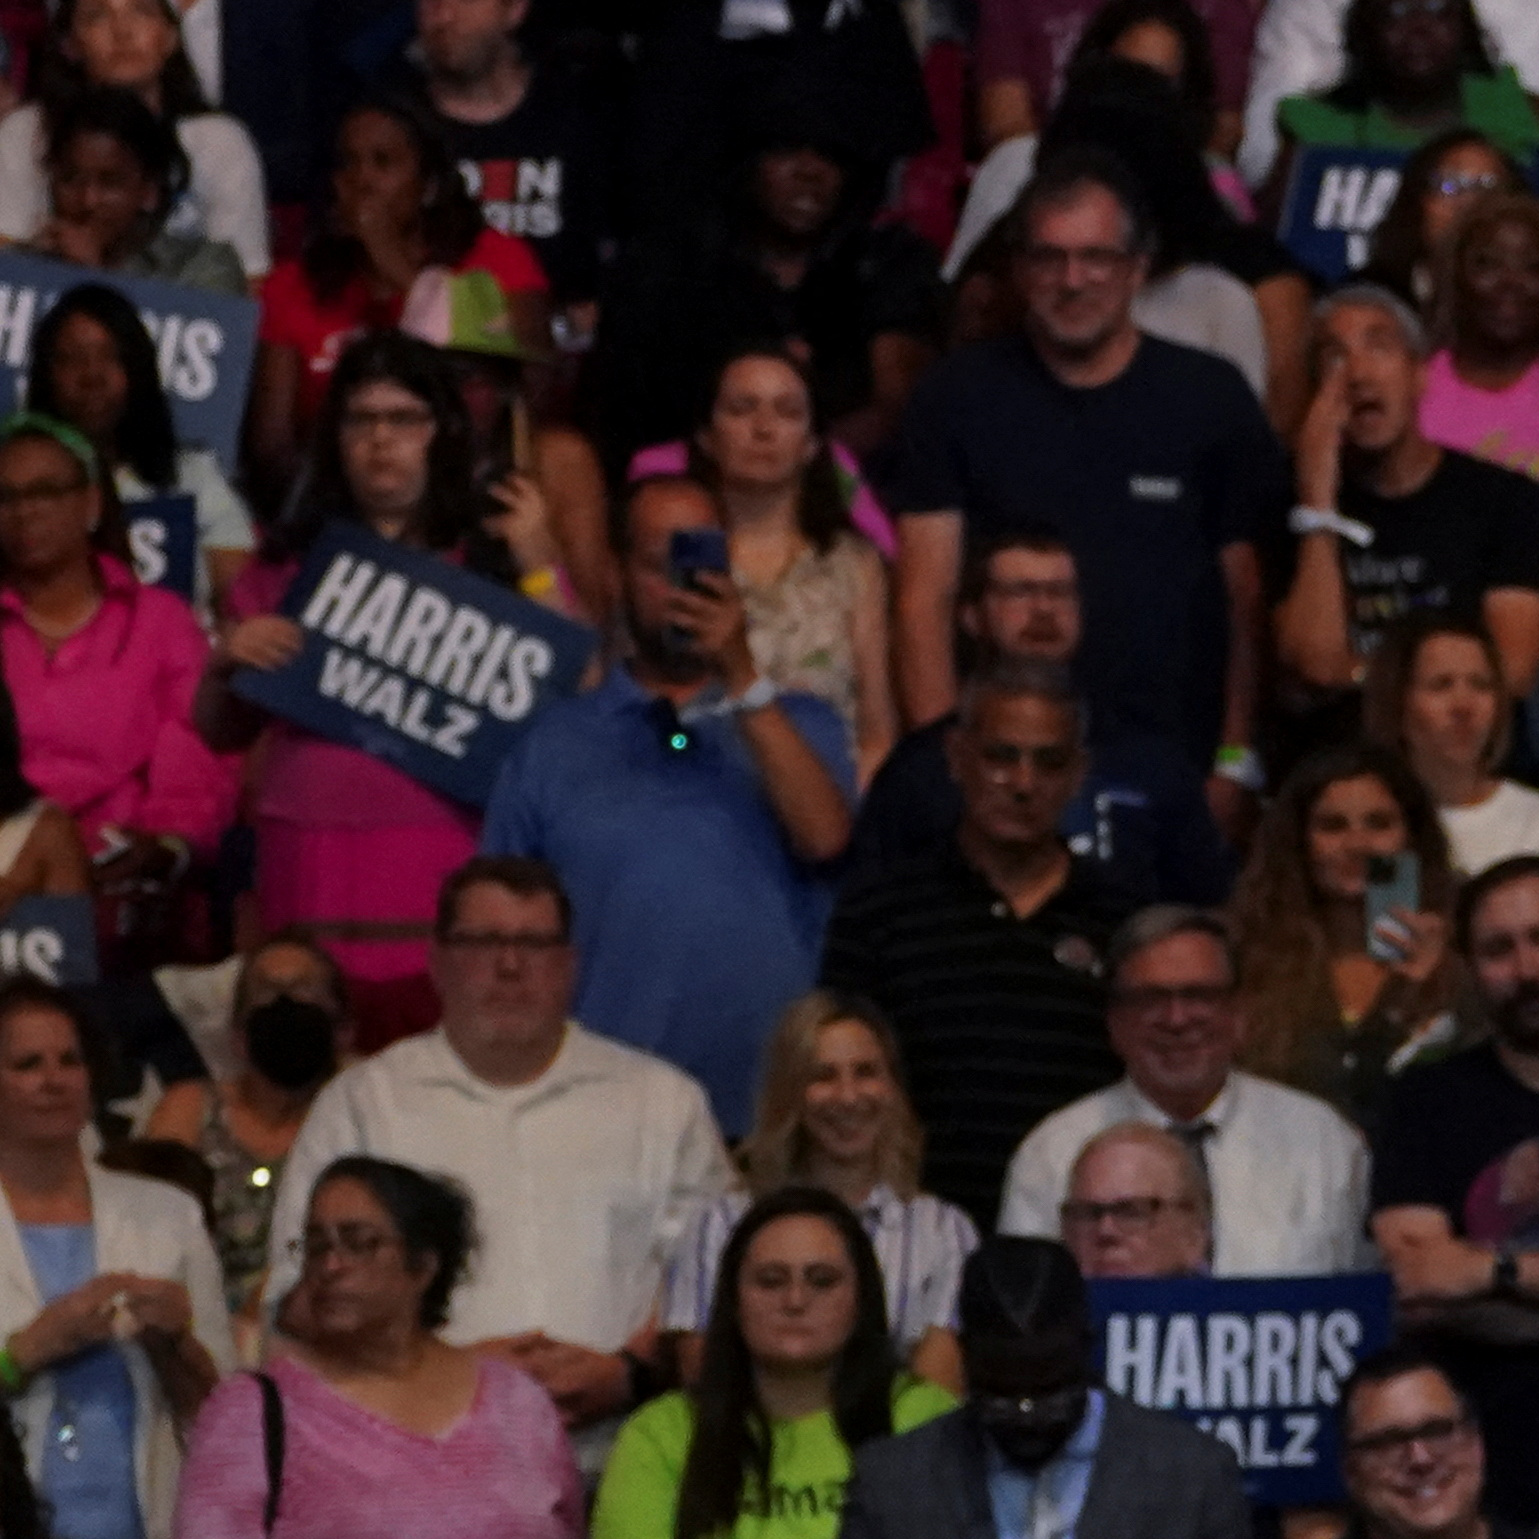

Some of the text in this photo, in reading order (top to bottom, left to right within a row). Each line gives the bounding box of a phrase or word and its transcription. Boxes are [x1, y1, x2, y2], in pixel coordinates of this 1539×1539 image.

[302, 552, 555, 722] HARRIS
[318, 648, 482, 759] WALZ
[1106, 1311, 1363, 1409] HARRIS
